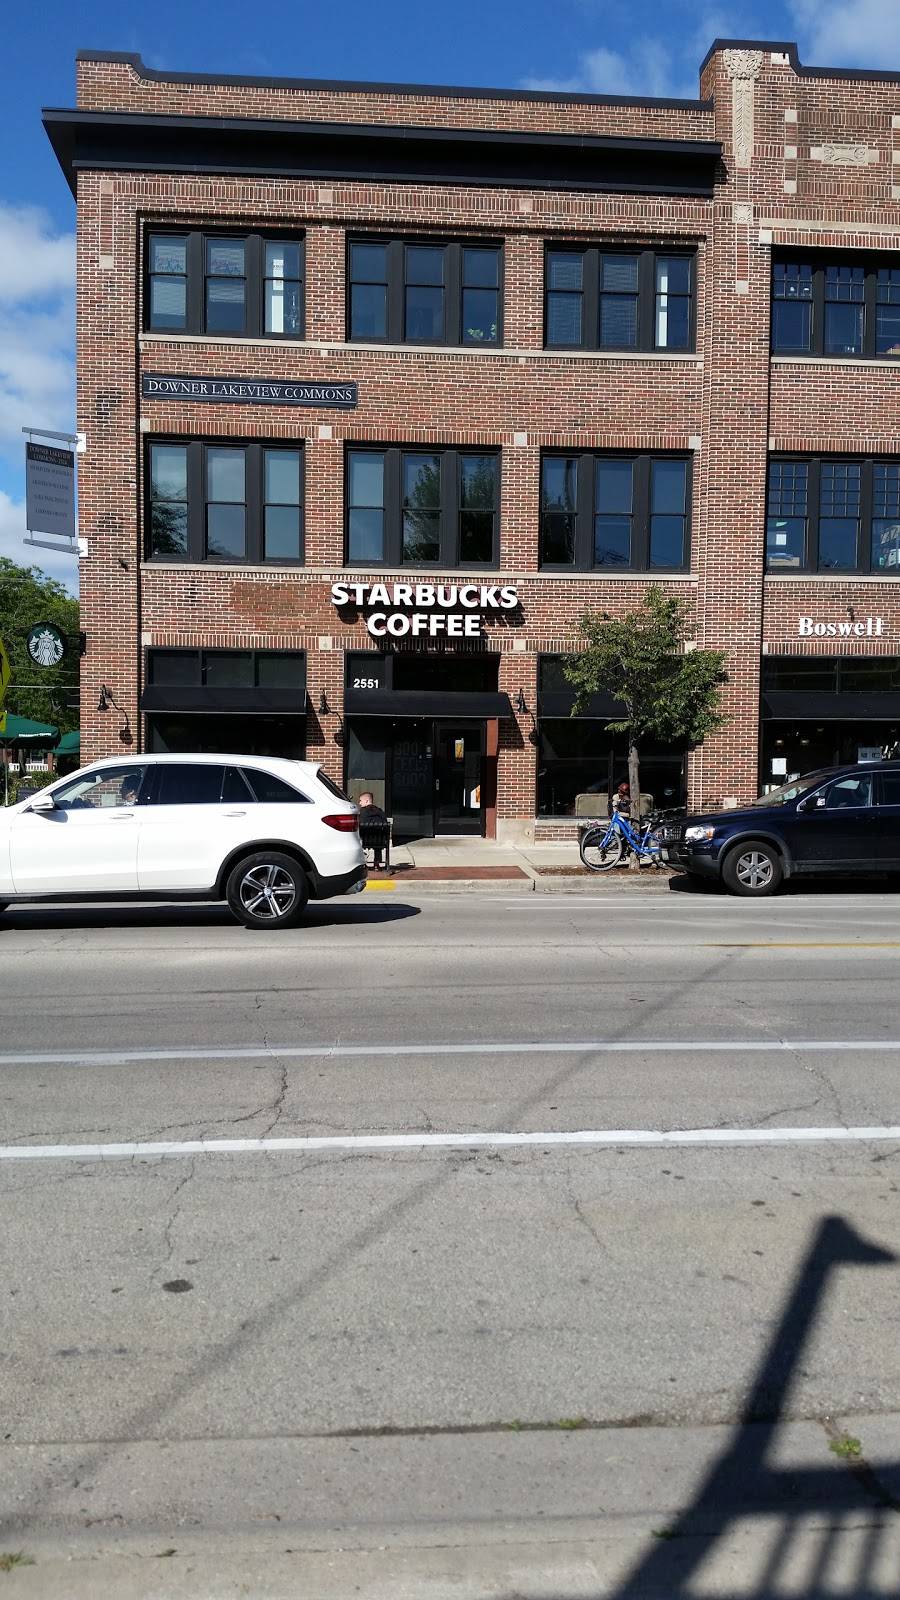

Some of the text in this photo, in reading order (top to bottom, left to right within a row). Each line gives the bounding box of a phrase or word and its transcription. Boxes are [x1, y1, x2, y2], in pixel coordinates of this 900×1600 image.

[148, 380, 353, 400] DOWNER LAKEVIEW COMMONS
[331, 583, 518, 608] STARBUCKS
[367, 613, 481, 636] COFFEE
[798, 617, 883, 636] Boswell
[353, 678, 379, 689] 2551
